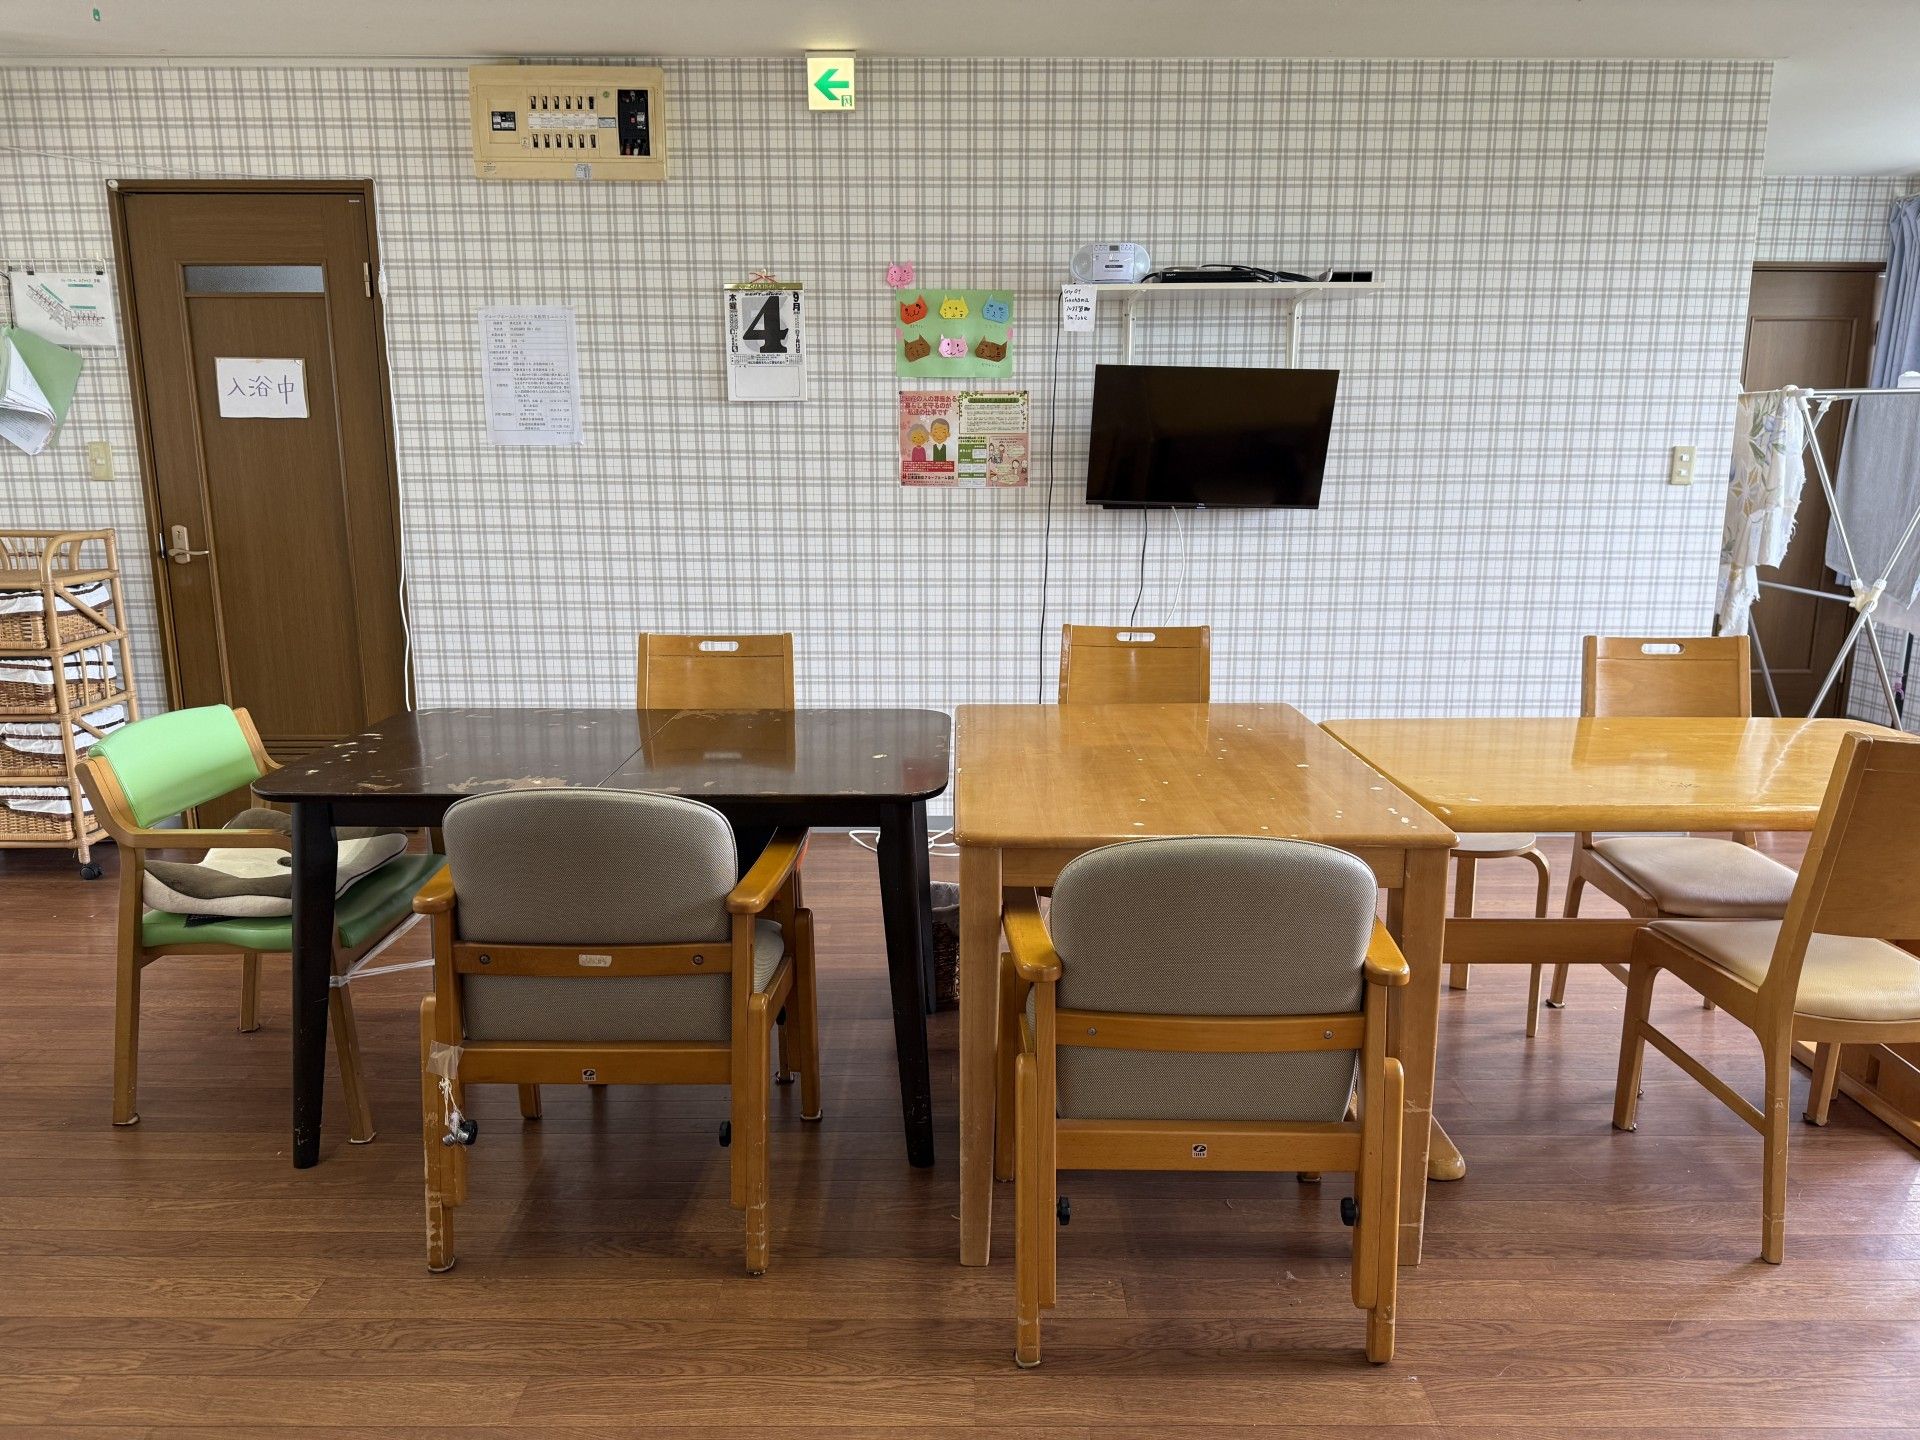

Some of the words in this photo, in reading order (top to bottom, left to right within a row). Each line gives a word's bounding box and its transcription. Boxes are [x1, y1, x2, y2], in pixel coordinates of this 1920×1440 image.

[743, 296, 789, 353] 4
[227, 374, 294, 405] 入浴中
